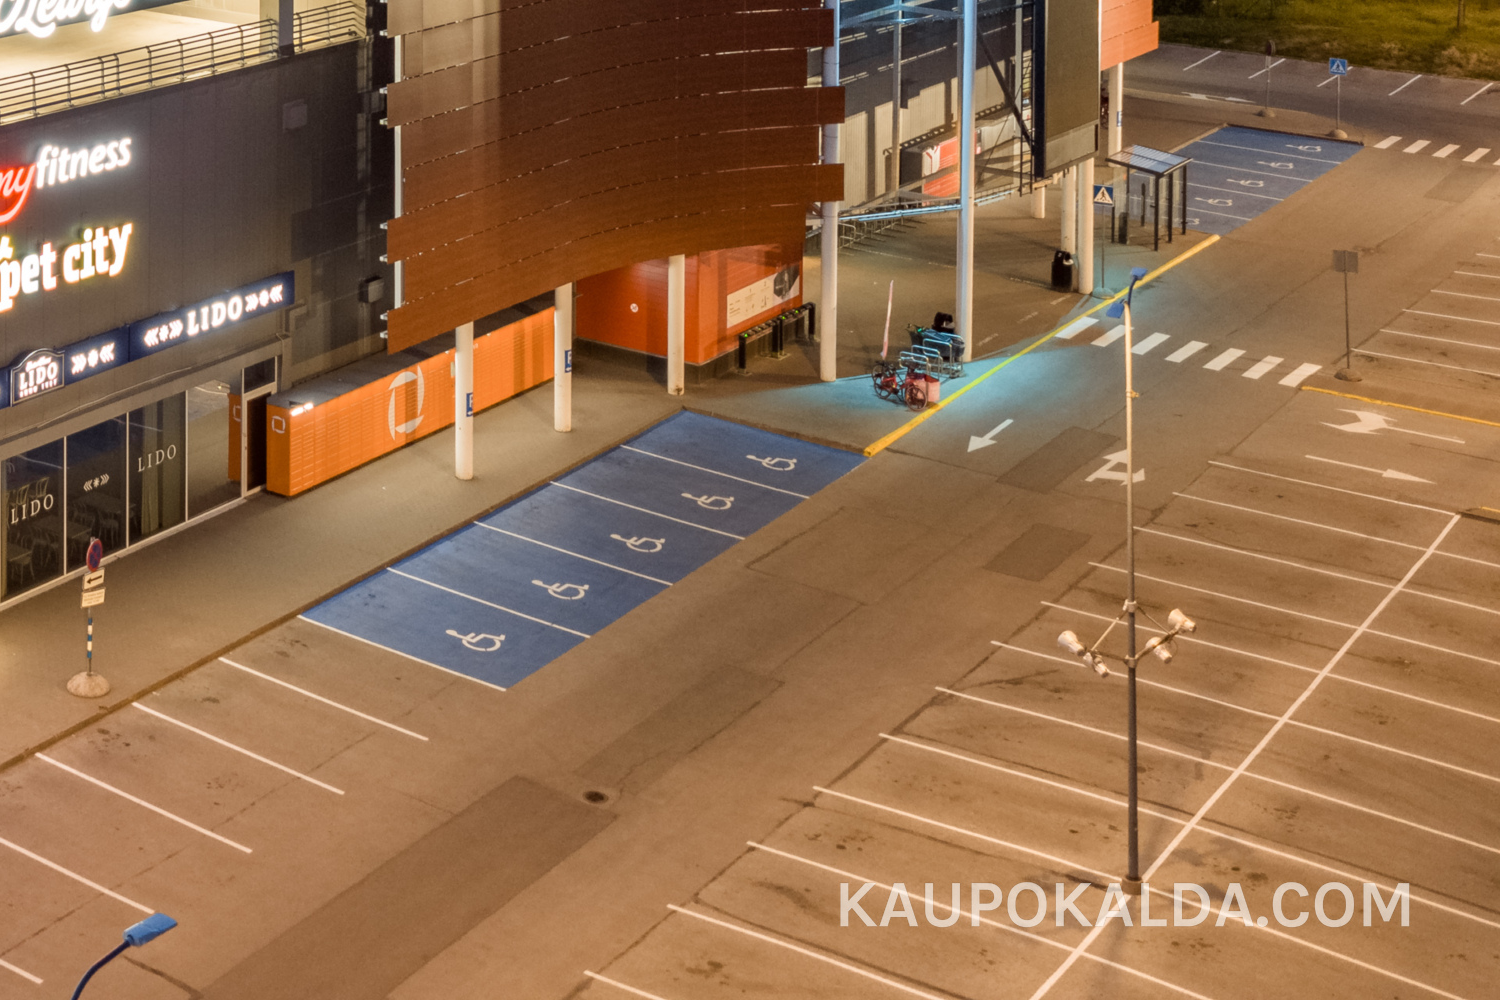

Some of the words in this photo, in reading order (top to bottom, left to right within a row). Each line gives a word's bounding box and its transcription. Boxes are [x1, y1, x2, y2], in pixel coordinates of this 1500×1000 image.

[63, 223, 133, 277] city
[186, 294, 244, 337] LIDO
[19, 362, 58, 391] LIDO
[138, 444, 177, 473] LIDO
[10, 494, 54, 526] LIDO
